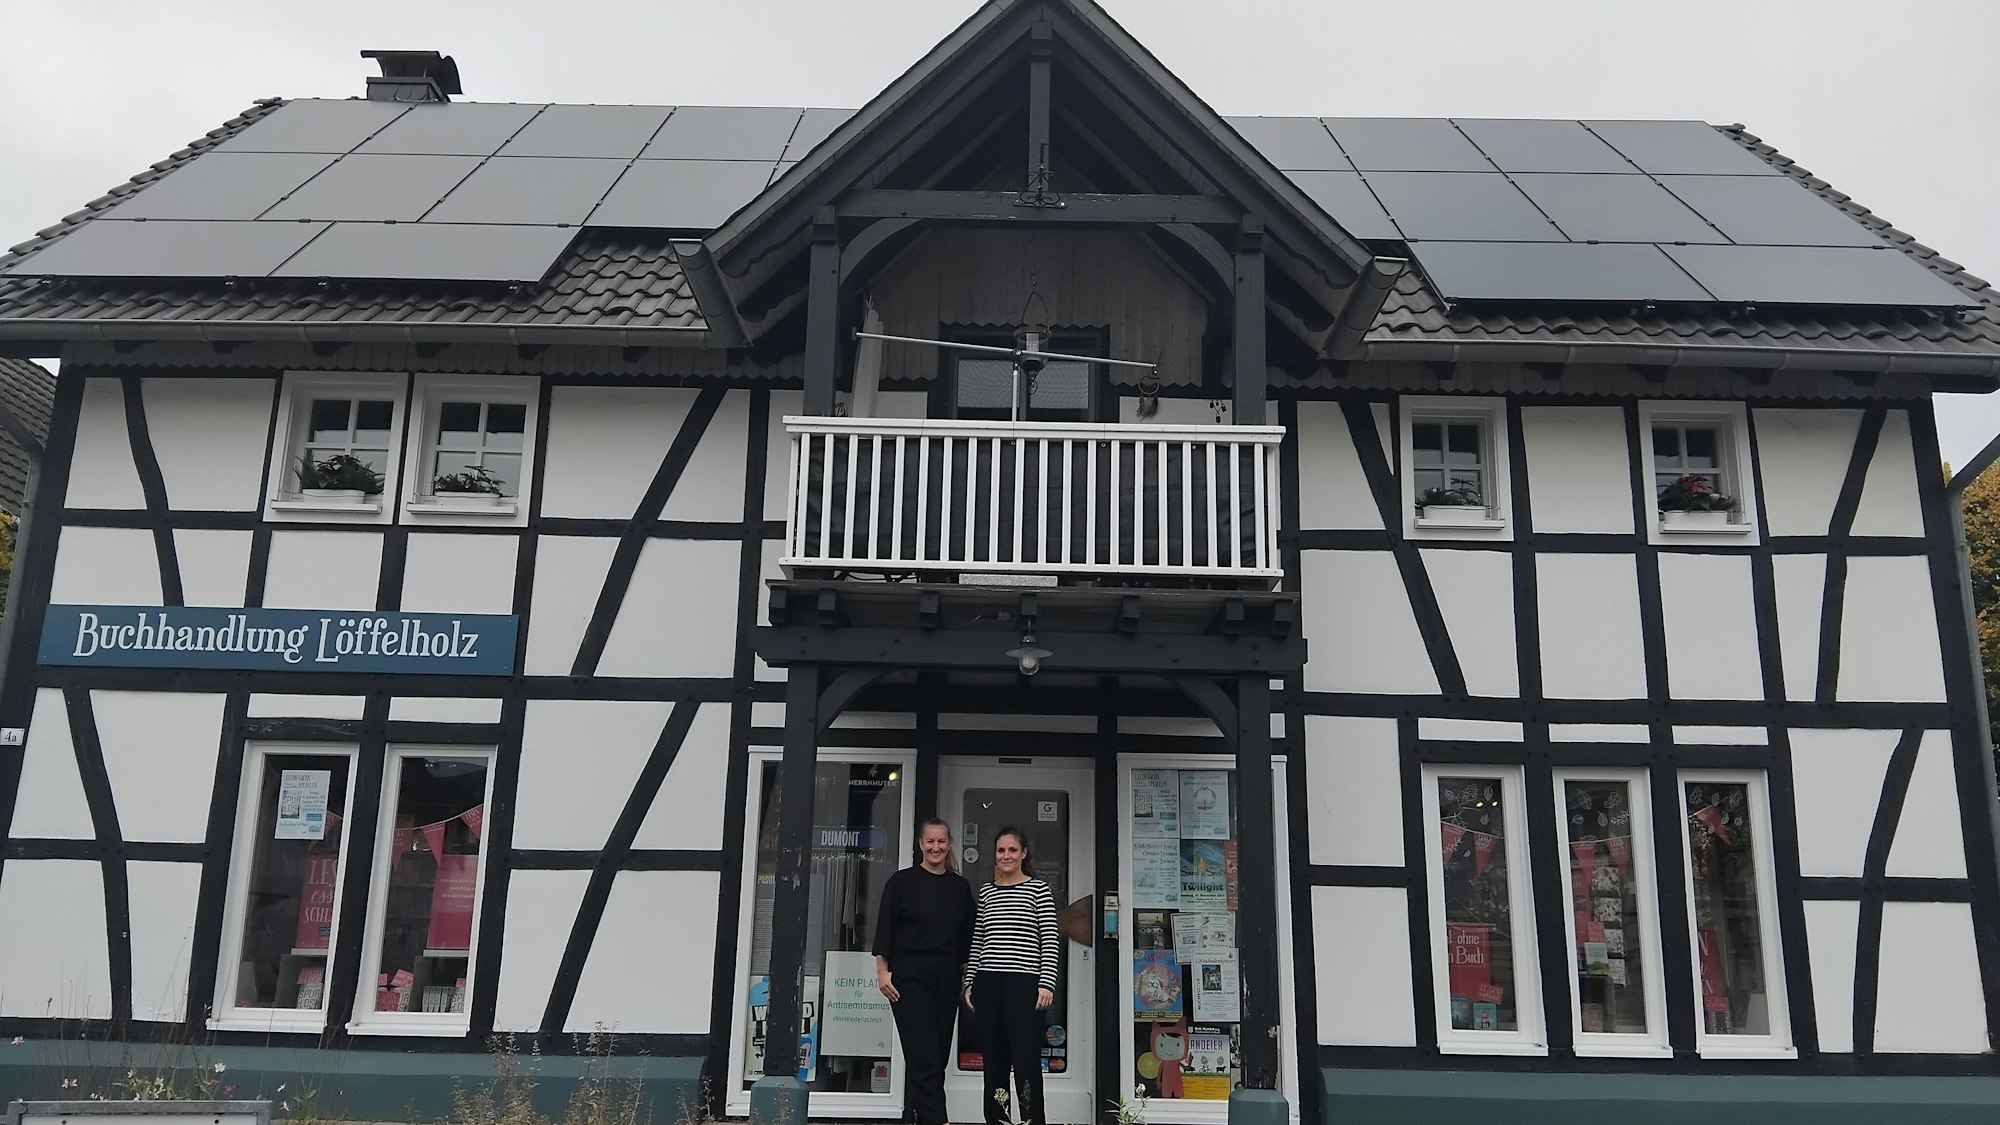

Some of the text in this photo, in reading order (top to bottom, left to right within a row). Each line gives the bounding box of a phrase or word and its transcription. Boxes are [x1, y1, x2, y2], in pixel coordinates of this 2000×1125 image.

[73, 613, 479, 664] Buchhandlung Löffelholz
[5, 732, 16, 742] 4a
[821, 830, 860, 846] DUMONT
[1182, 882, 1224, 892] Twilight
[1457, 930, 1479, 945] ohne
[1456, 946, 1484, 964] Buch
[834, 978, 878, 987] KEIN PLAT
[827, 1000, 890, 1010] Antisemitismus
[1188, 1040, 1223, 1050] ANDEIER
